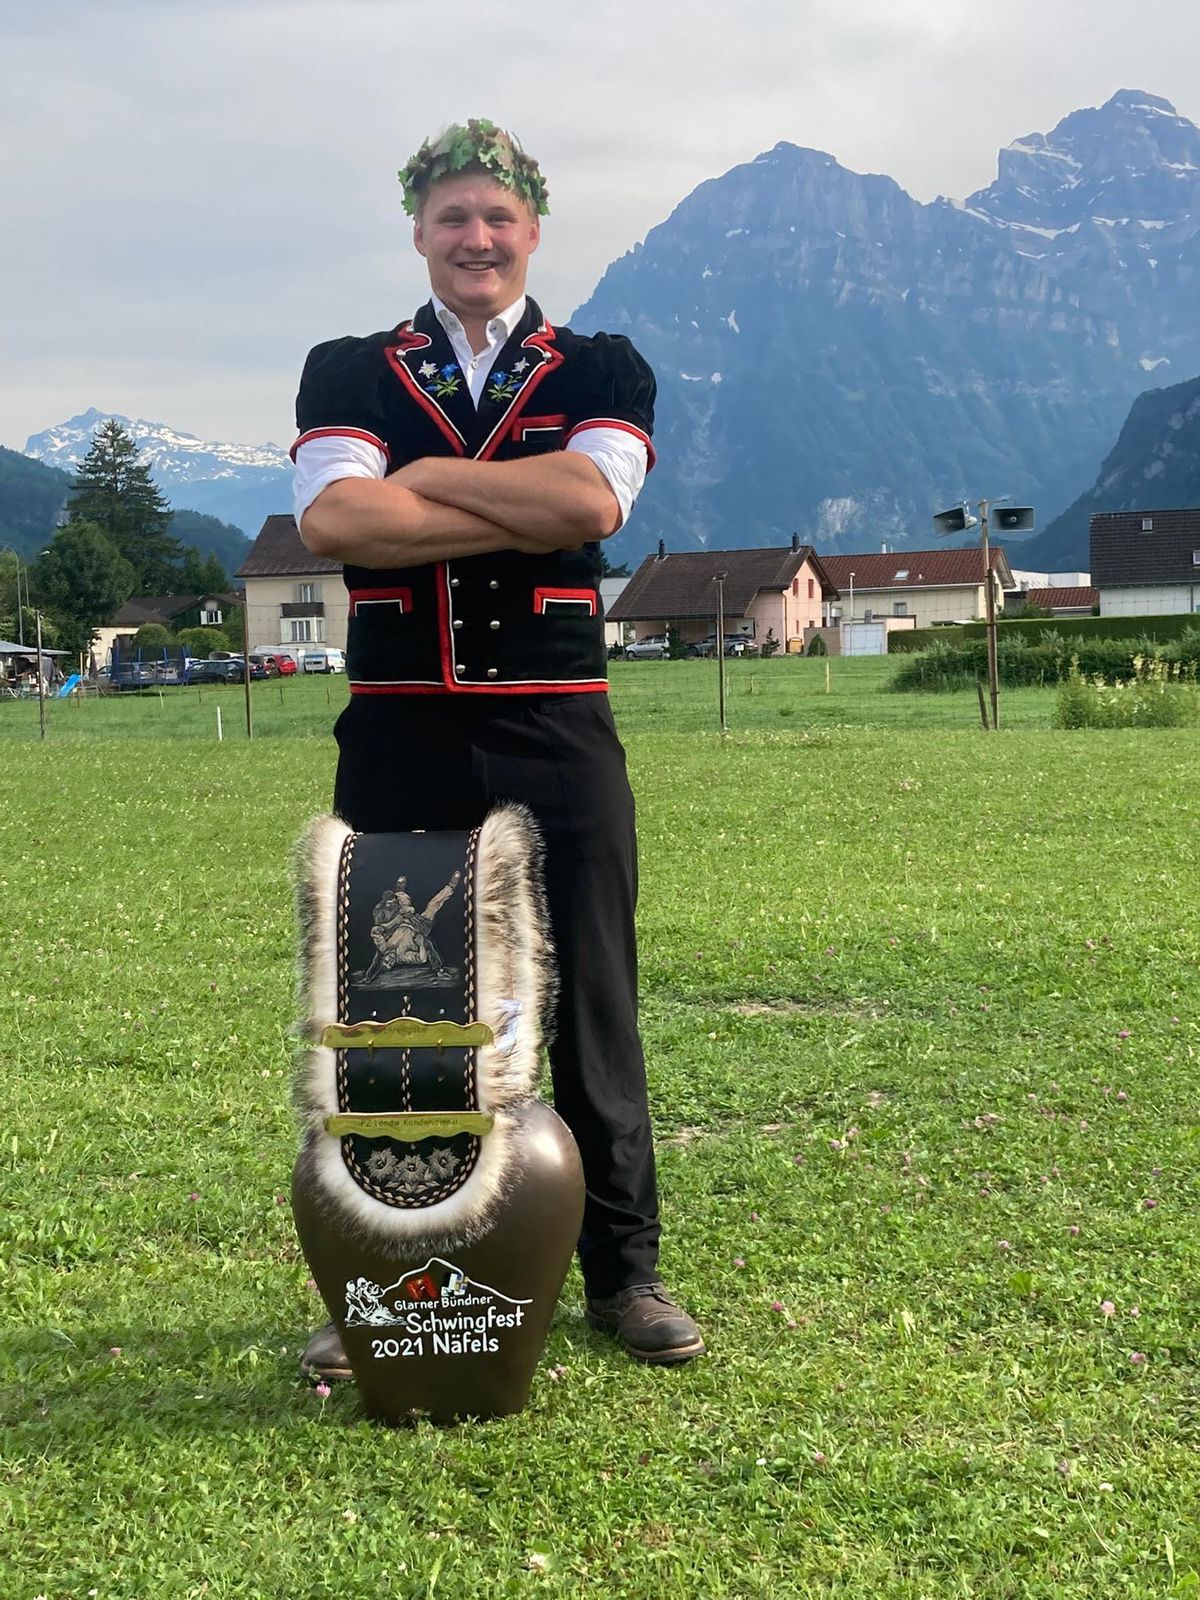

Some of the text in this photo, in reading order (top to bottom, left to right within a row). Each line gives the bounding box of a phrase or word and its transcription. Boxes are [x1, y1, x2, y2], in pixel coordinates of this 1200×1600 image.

[394, 1294, 493, 1311] Glarner Bündner
[406, 1305, 525, 1334] Schwingfest
[371, 1331, 500, 1359] 2021 Näfels
